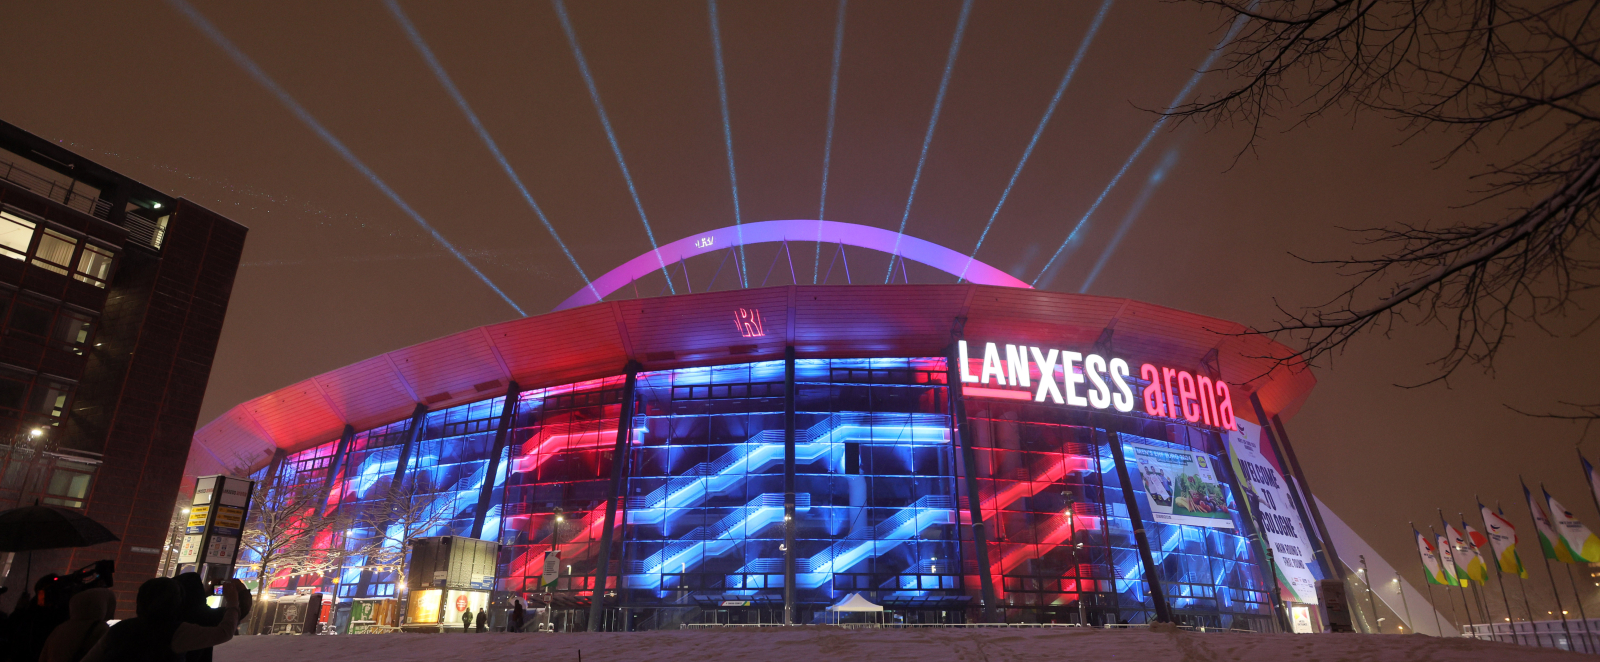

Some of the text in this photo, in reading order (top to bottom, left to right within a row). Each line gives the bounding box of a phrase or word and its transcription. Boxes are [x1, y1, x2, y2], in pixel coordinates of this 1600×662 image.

[958, 340, 1238, 431] LANXESS arena
[1238, 458, 1280, 489] WELCOME
[1261, 488, 1276, 511] TO
[1262, 511, 1298, 538] COLOGNE
[1285, 543, 1299, 556] ROUND
[1291, 558, 1305, 570] ROUND
